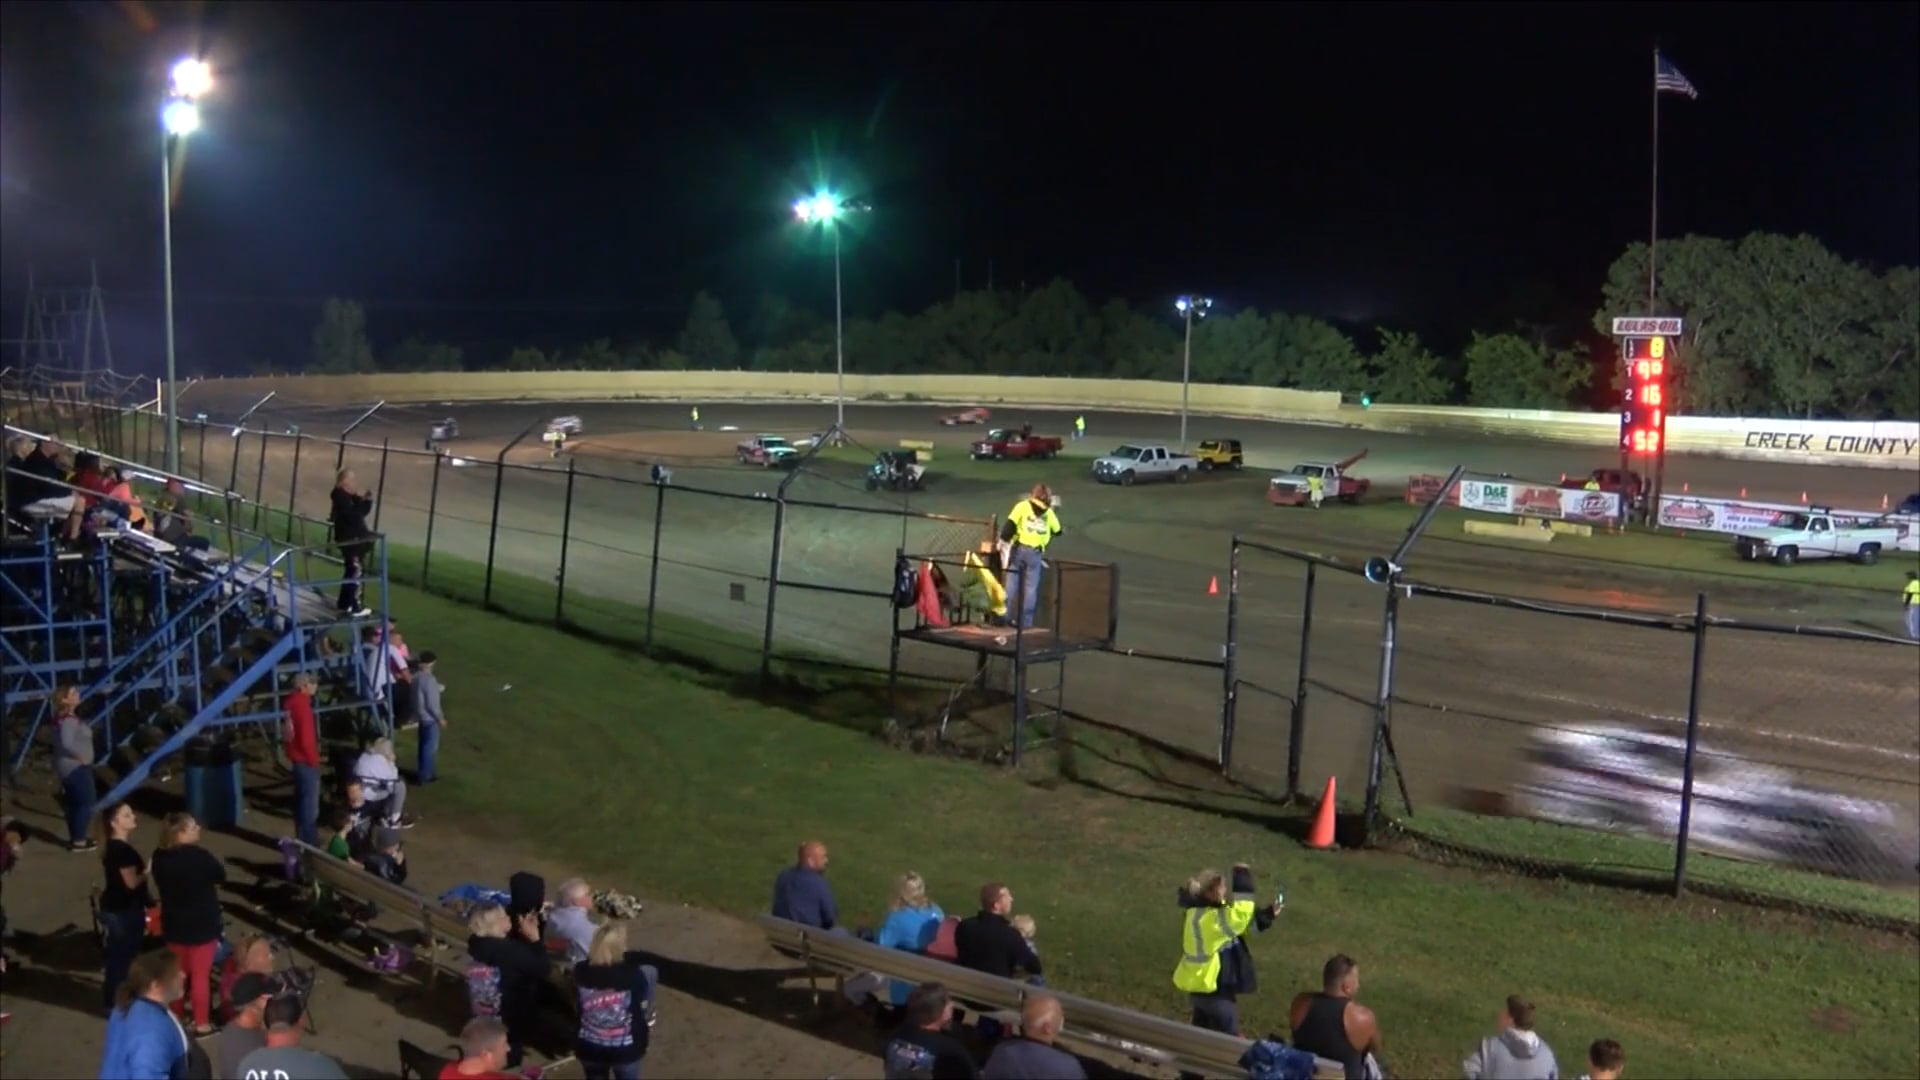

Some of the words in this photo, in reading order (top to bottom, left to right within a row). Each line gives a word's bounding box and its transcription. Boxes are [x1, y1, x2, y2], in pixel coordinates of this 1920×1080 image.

[1659, 320, 1680, 333] OIL
[1625, 389, 1632, 400] 2
[1642, 384, 1662, 405] 16
[1624, 411, 1631, 423] 3
[1653, 409, 1660, 427] 1
[1623, 435, 1630, 446] 4
[1634, 429, 1659, 451] 52
[1745, 431, 1814, 450] CREEK
[1826, 435, 1917, 455] COUNTY
[1483, 484, 1508, 497] D&E
